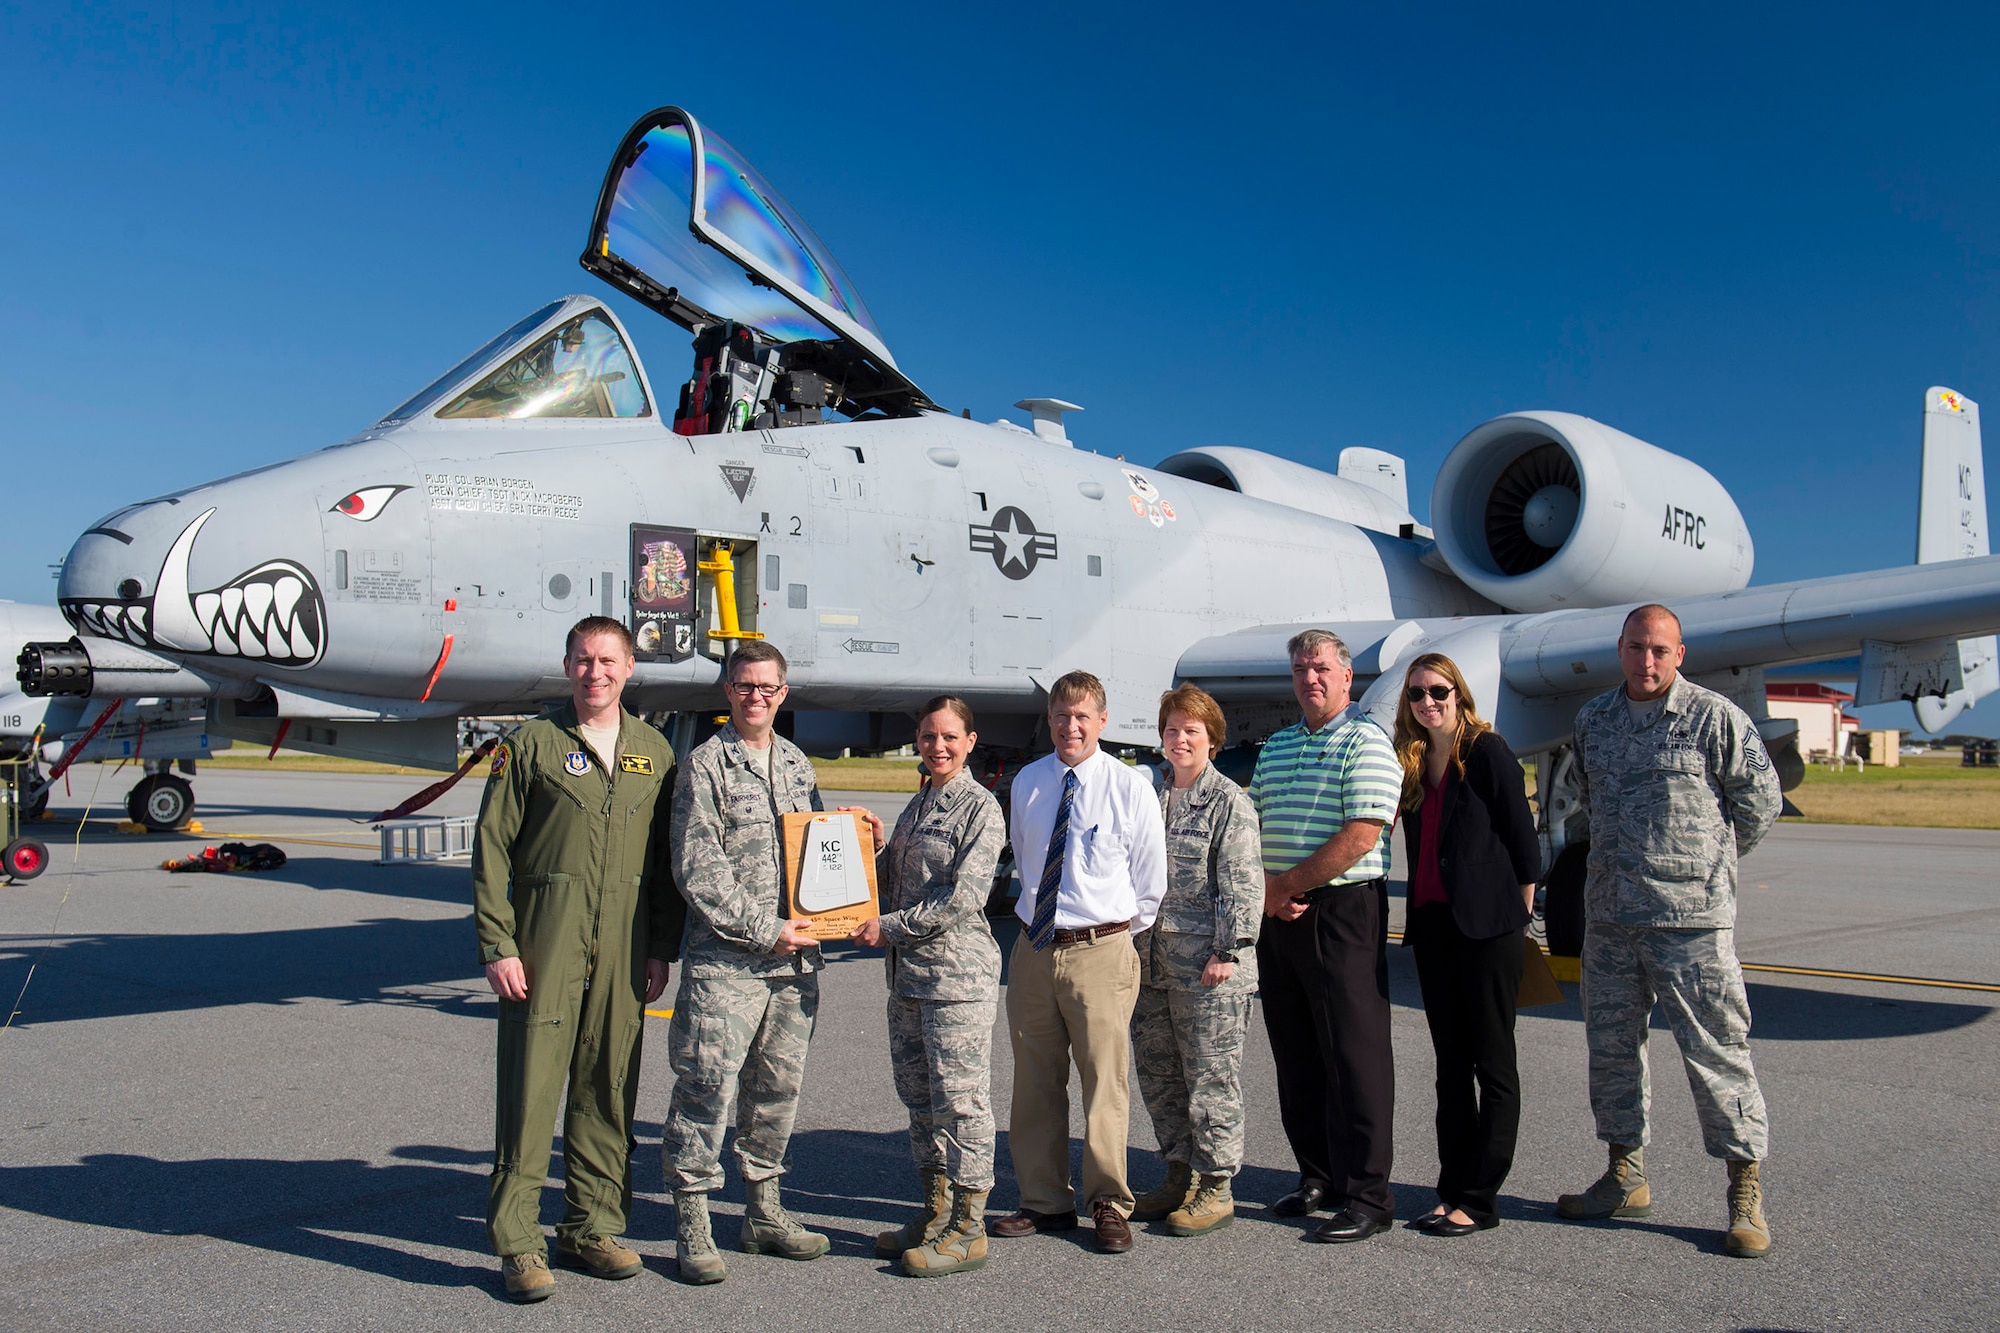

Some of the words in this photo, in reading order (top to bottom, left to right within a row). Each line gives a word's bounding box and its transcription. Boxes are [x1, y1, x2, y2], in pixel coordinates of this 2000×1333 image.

[425, 474, 452, 484] PILOT:
[455, 476, 472, 486] COL
[475, 476, 498, 486] BRIAN
[502, 478, 534, 490] BORGEN
[720, 473, 734, 495] DANGER
[747, 476, 756, 496] DANGER
[1959, 464, 1971, 500] KC
[428, 486, 454, 496] CREW
[458, 487, 486, 498] CHIEF:
[489, 489, 509, 500] TSGT
[513, 491, 530, 502] NICK
[535, 493, 583, 507] MCROBERTS
[456, 499, 478, 511] CREW
[482, 500, 507, 513] CHIEF:
[510, 503, 525, 514] SRA
[528, 504, 551, 516] TERRY
[554, 507, 579, 520] REECE
[1662, 504, 1706, 550] AFRC
[852, 641, 873, 652] RESCUE
[4, 715, 22, 727] 118
[821, 840, 840, 852] KC
[822, 854, 836, 863] 442
